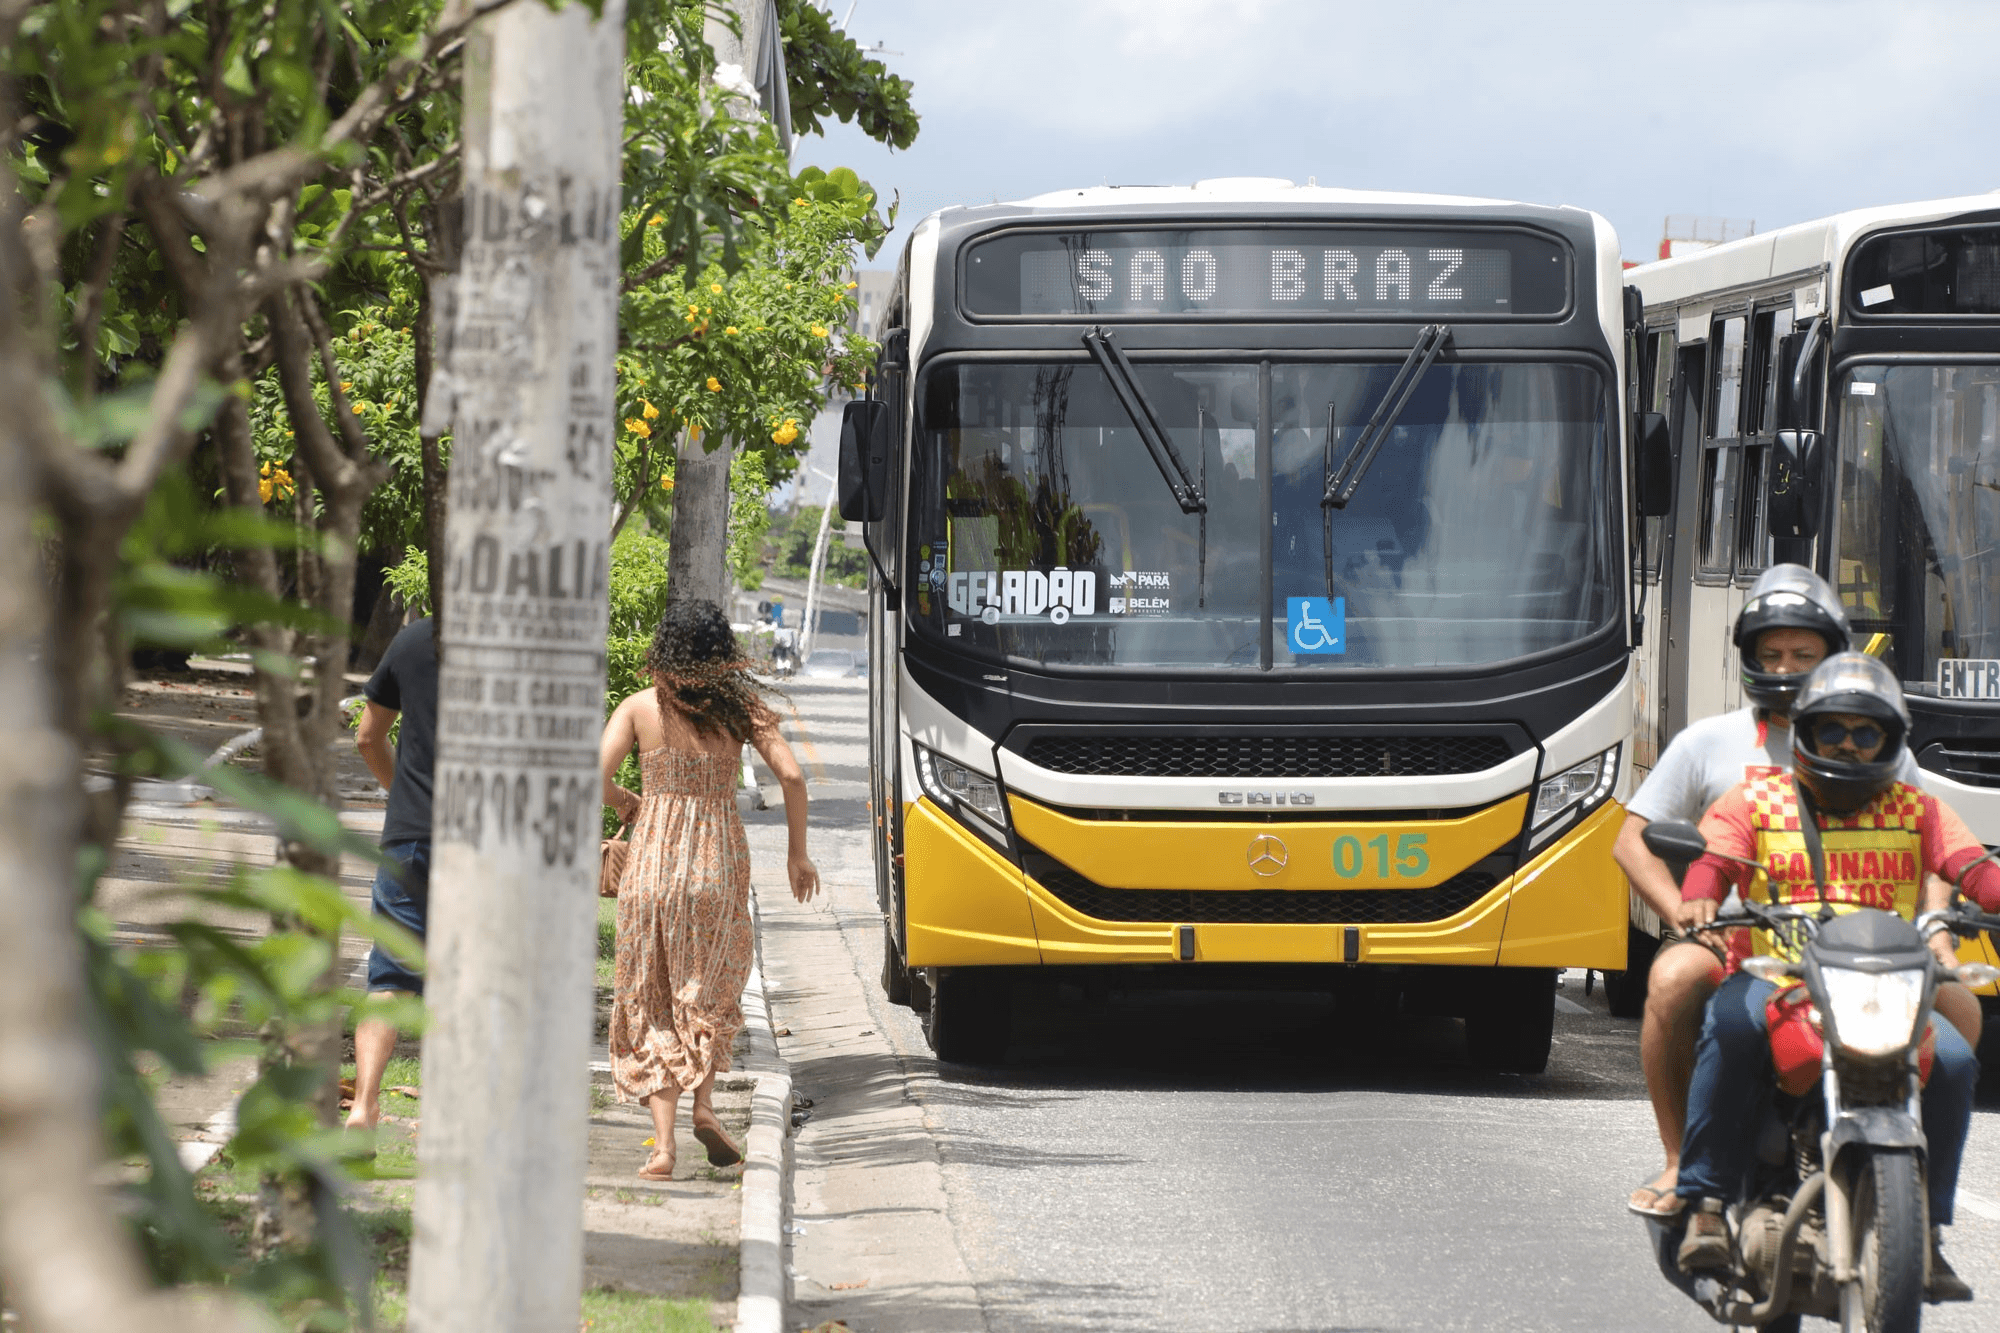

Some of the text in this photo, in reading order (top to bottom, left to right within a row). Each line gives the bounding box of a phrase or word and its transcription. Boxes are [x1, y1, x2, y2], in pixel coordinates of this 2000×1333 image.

[1272, 249, 1462, 301] BRAZ
[1130, 597, 1170, 609] BELÉM
[1332, 833, 1431, 879] 015
[1769, 850, 1916, 882] CAINANA
